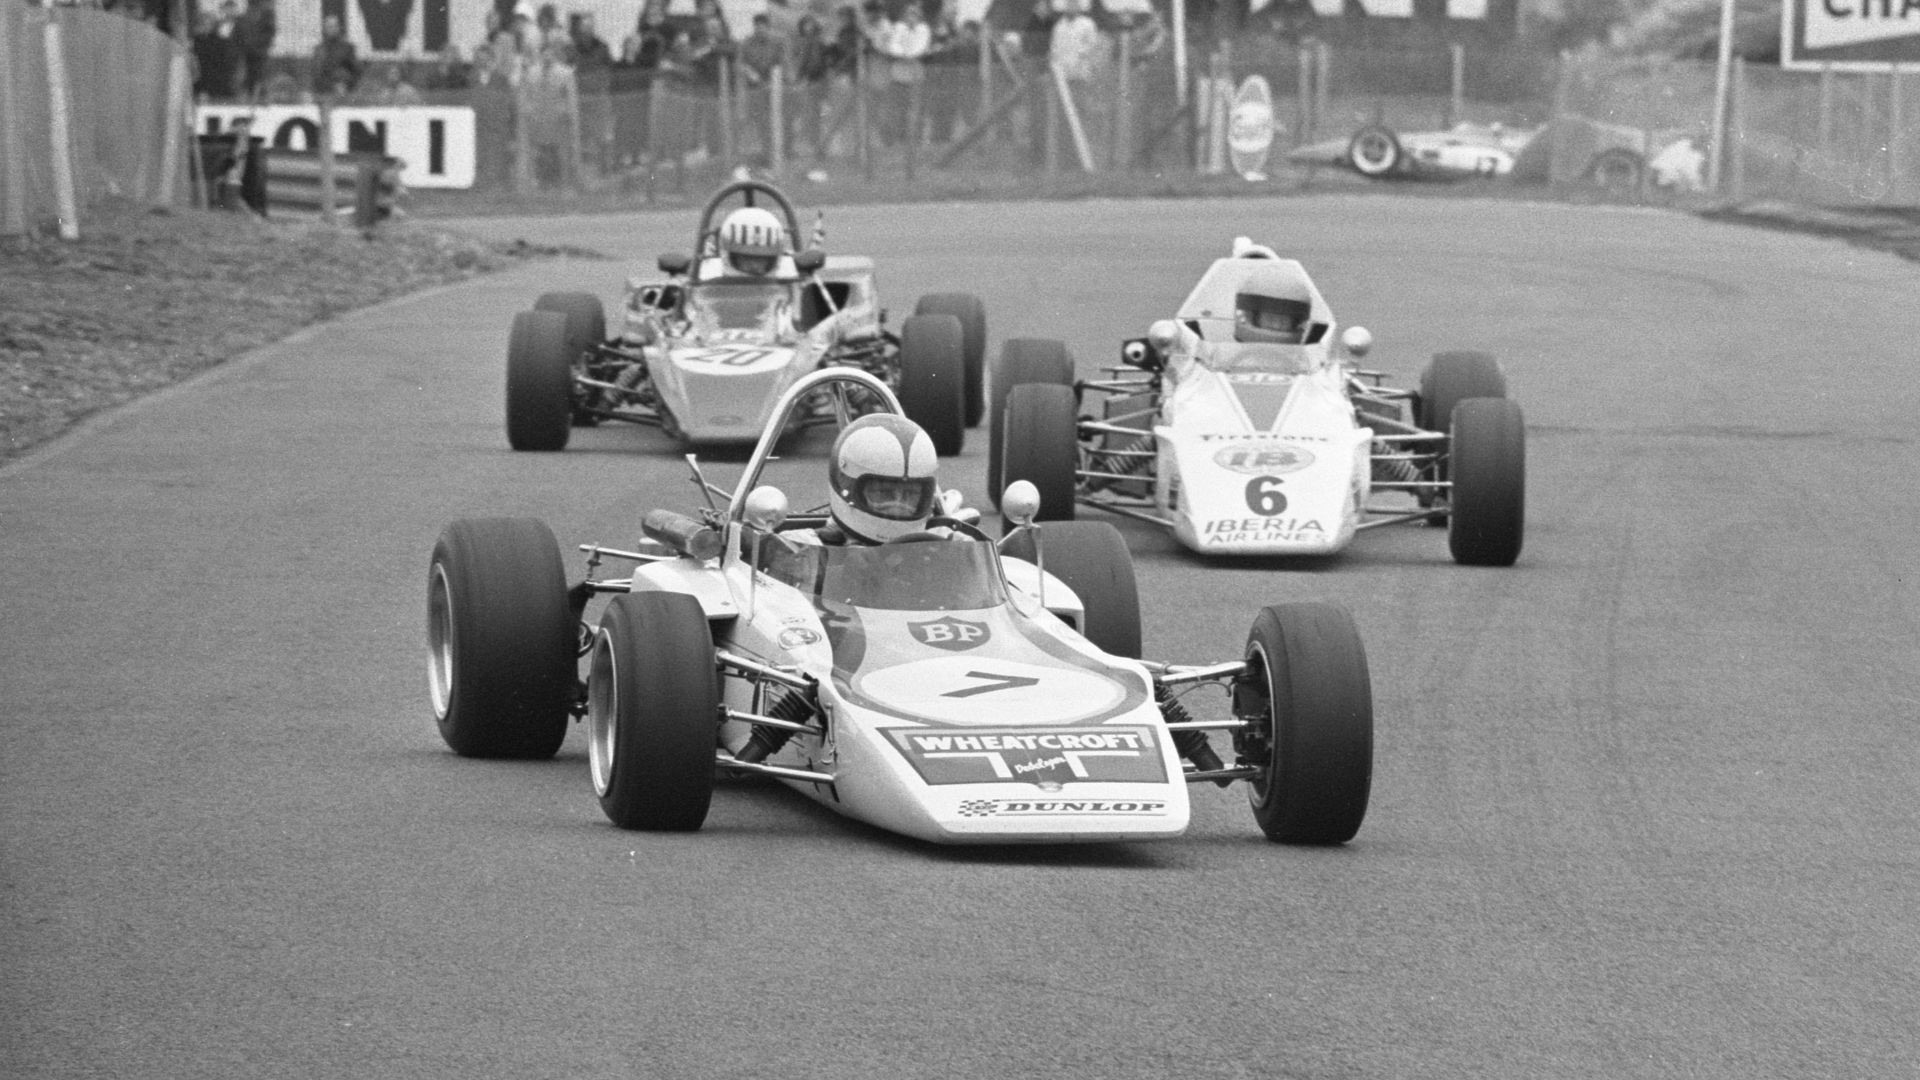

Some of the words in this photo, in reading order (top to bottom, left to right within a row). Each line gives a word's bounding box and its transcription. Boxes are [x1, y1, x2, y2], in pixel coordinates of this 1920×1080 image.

[684, 348, 774, 366] 20
[1245, 475, 1288, 517] 6
[1204, 518, 1325, 534] IBERIA
[921, 623, 984, 643] BP
[938, 670, 1041, 699] 7
[913, 733, 1139, 751] WHEATCROFT
[1003, 803, 1166, 812] DUNLOP
